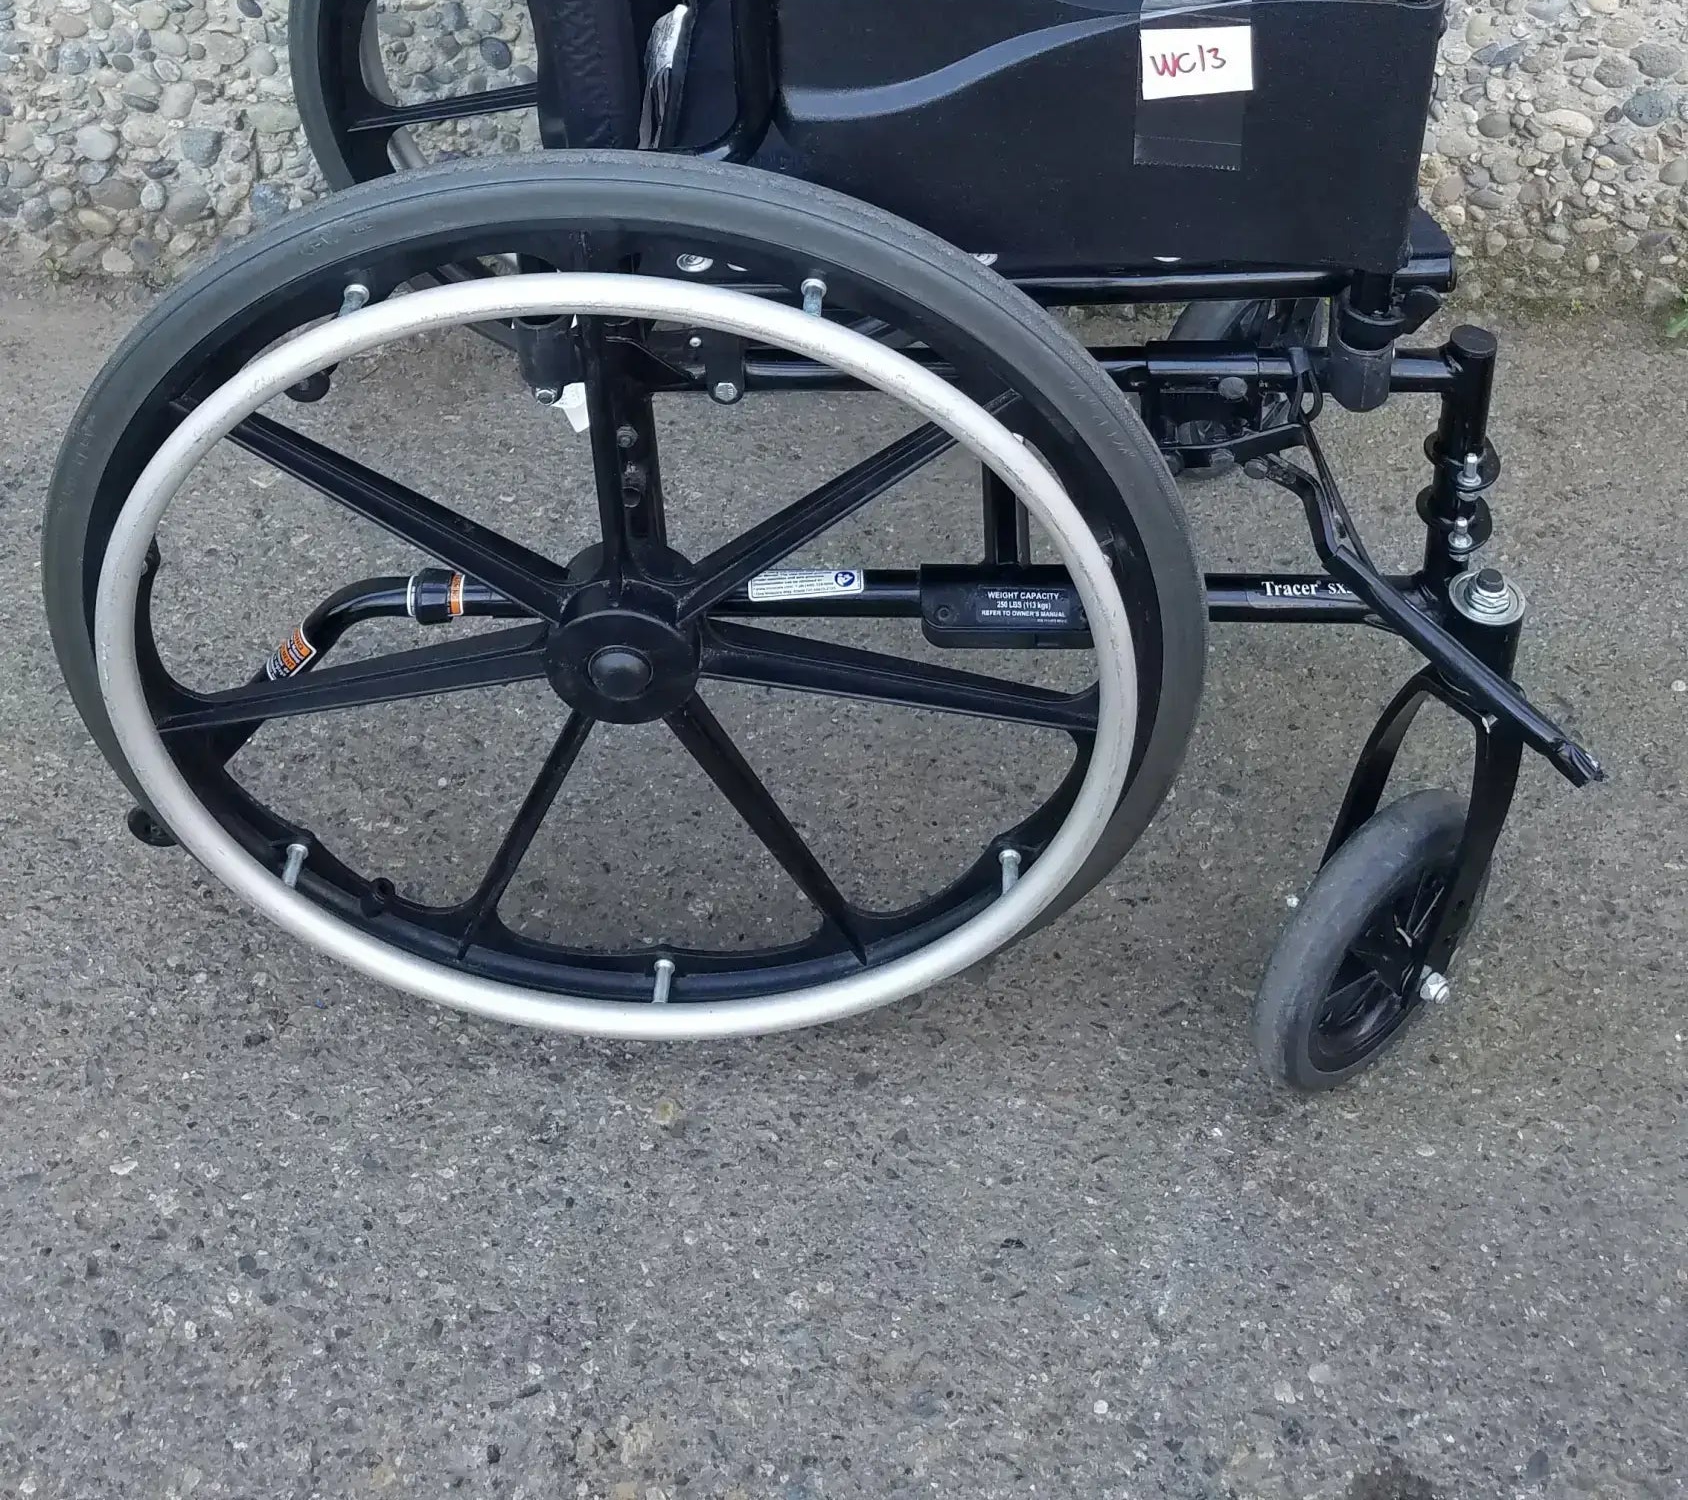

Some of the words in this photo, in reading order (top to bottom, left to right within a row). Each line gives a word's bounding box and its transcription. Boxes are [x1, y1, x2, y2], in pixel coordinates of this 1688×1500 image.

[1261, 581, 1319, 597] Tracer
[1327, 582, 1354, 595] SX
[987, 591, 1018, 600] WEIGHT
[1020, 591, 1060, 601] CAPACITY
